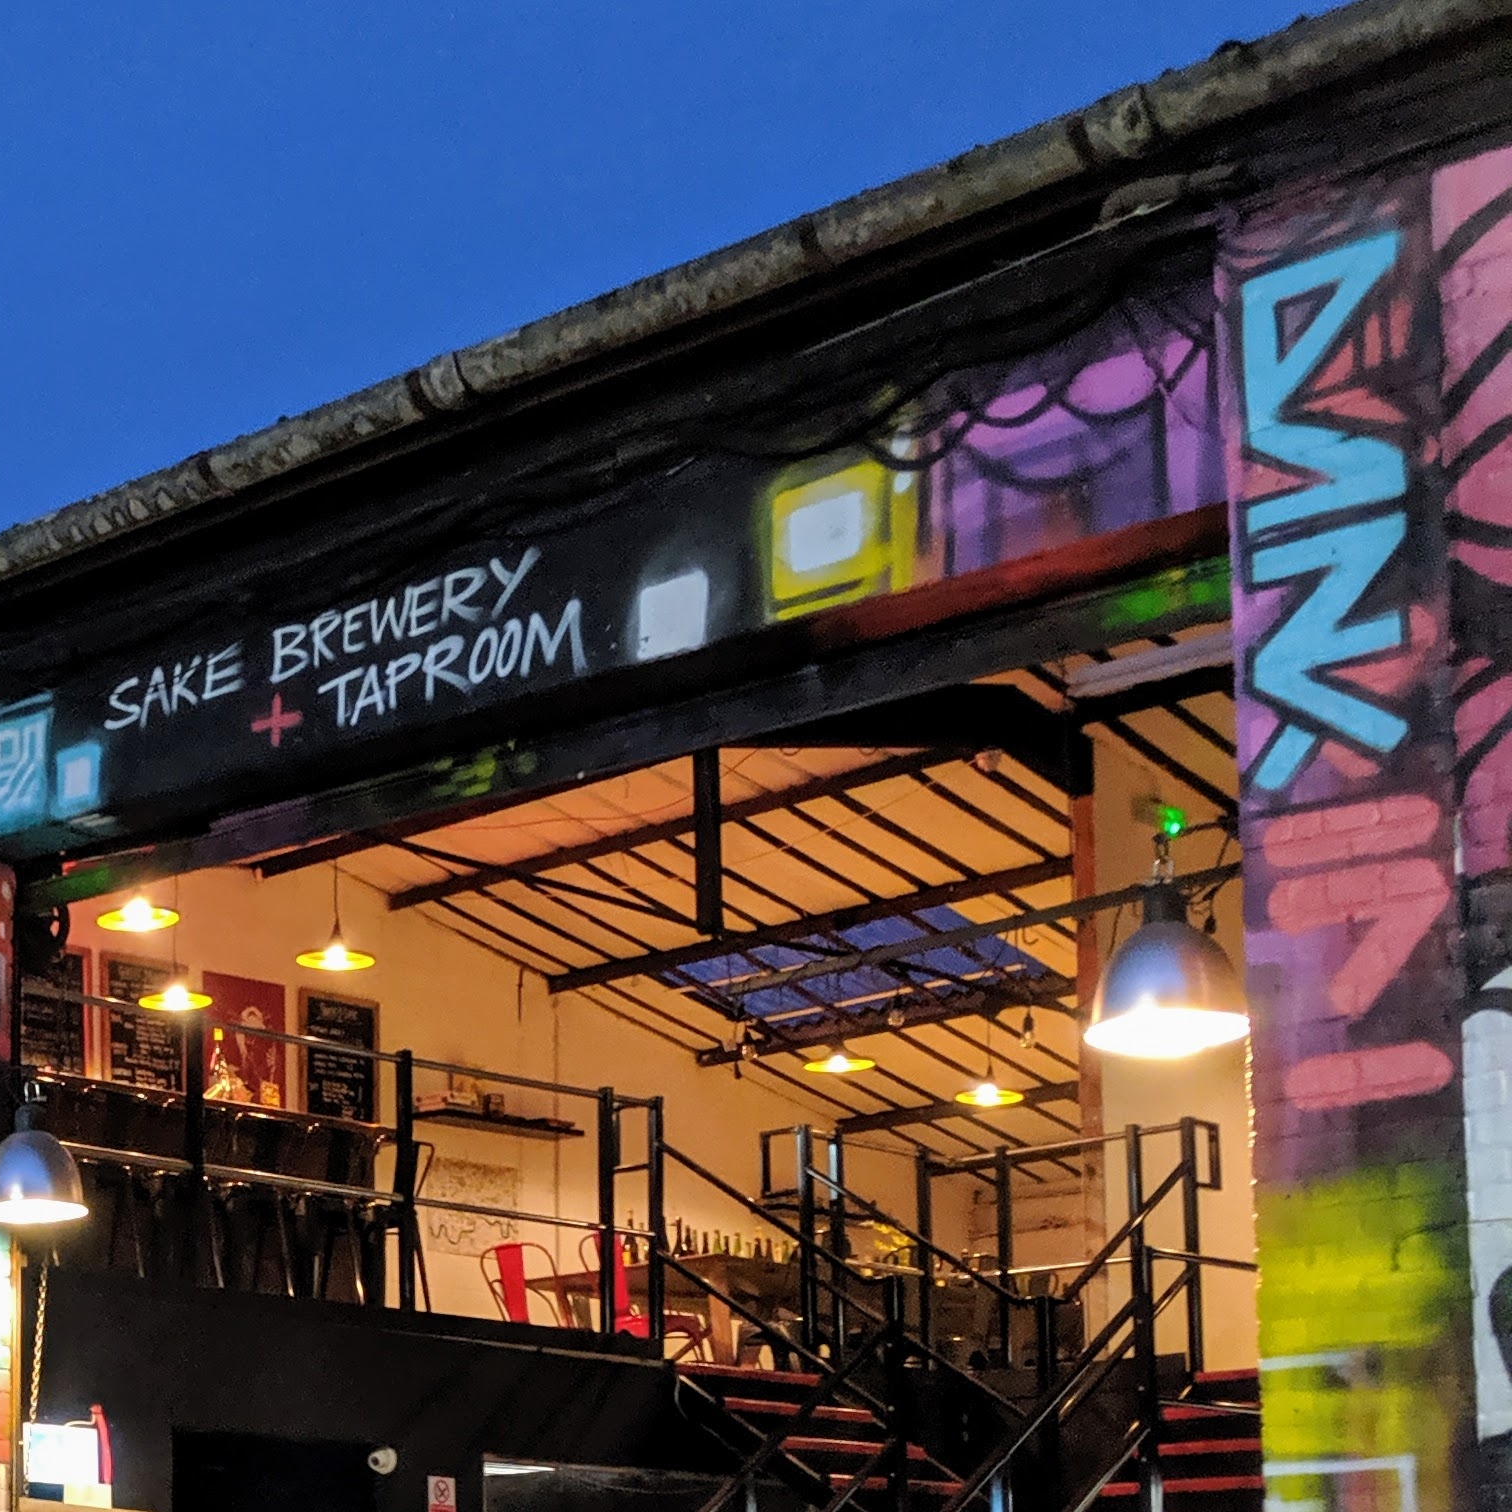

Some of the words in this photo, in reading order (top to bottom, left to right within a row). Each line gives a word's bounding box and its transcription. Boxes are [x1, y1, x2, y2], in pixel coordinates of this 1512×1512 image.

[103, 642, 245, 730] SAKE
[269, 546, 542, 684] BREWERY
[318, 597, 588, 727] TAPROOM
